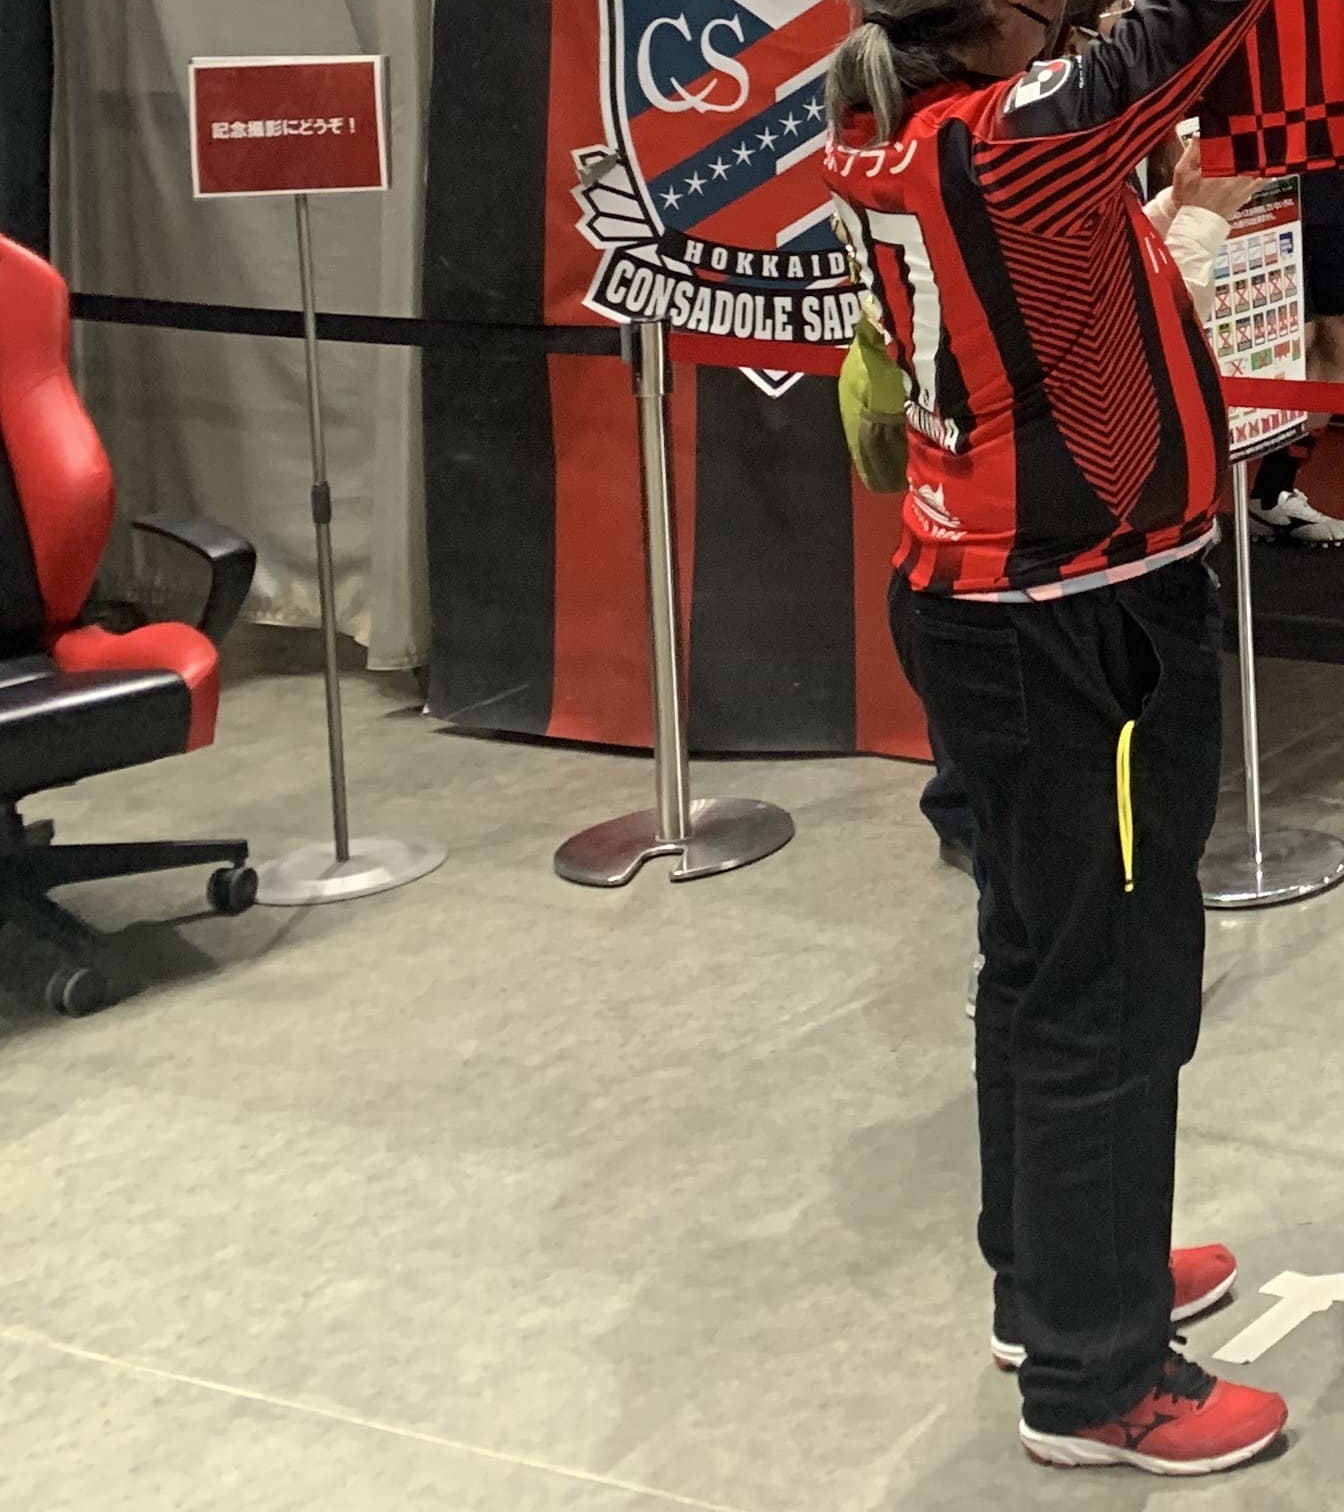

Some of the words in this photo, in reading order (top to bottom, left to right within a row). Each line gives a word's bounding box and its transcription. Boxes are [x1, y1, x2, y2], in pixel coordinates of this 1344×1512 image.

[684, 240, 847, 278] HOKKAID
[604, 259, 794, 341] CONSADOLE
[802, 294, 870, 343] SAP
